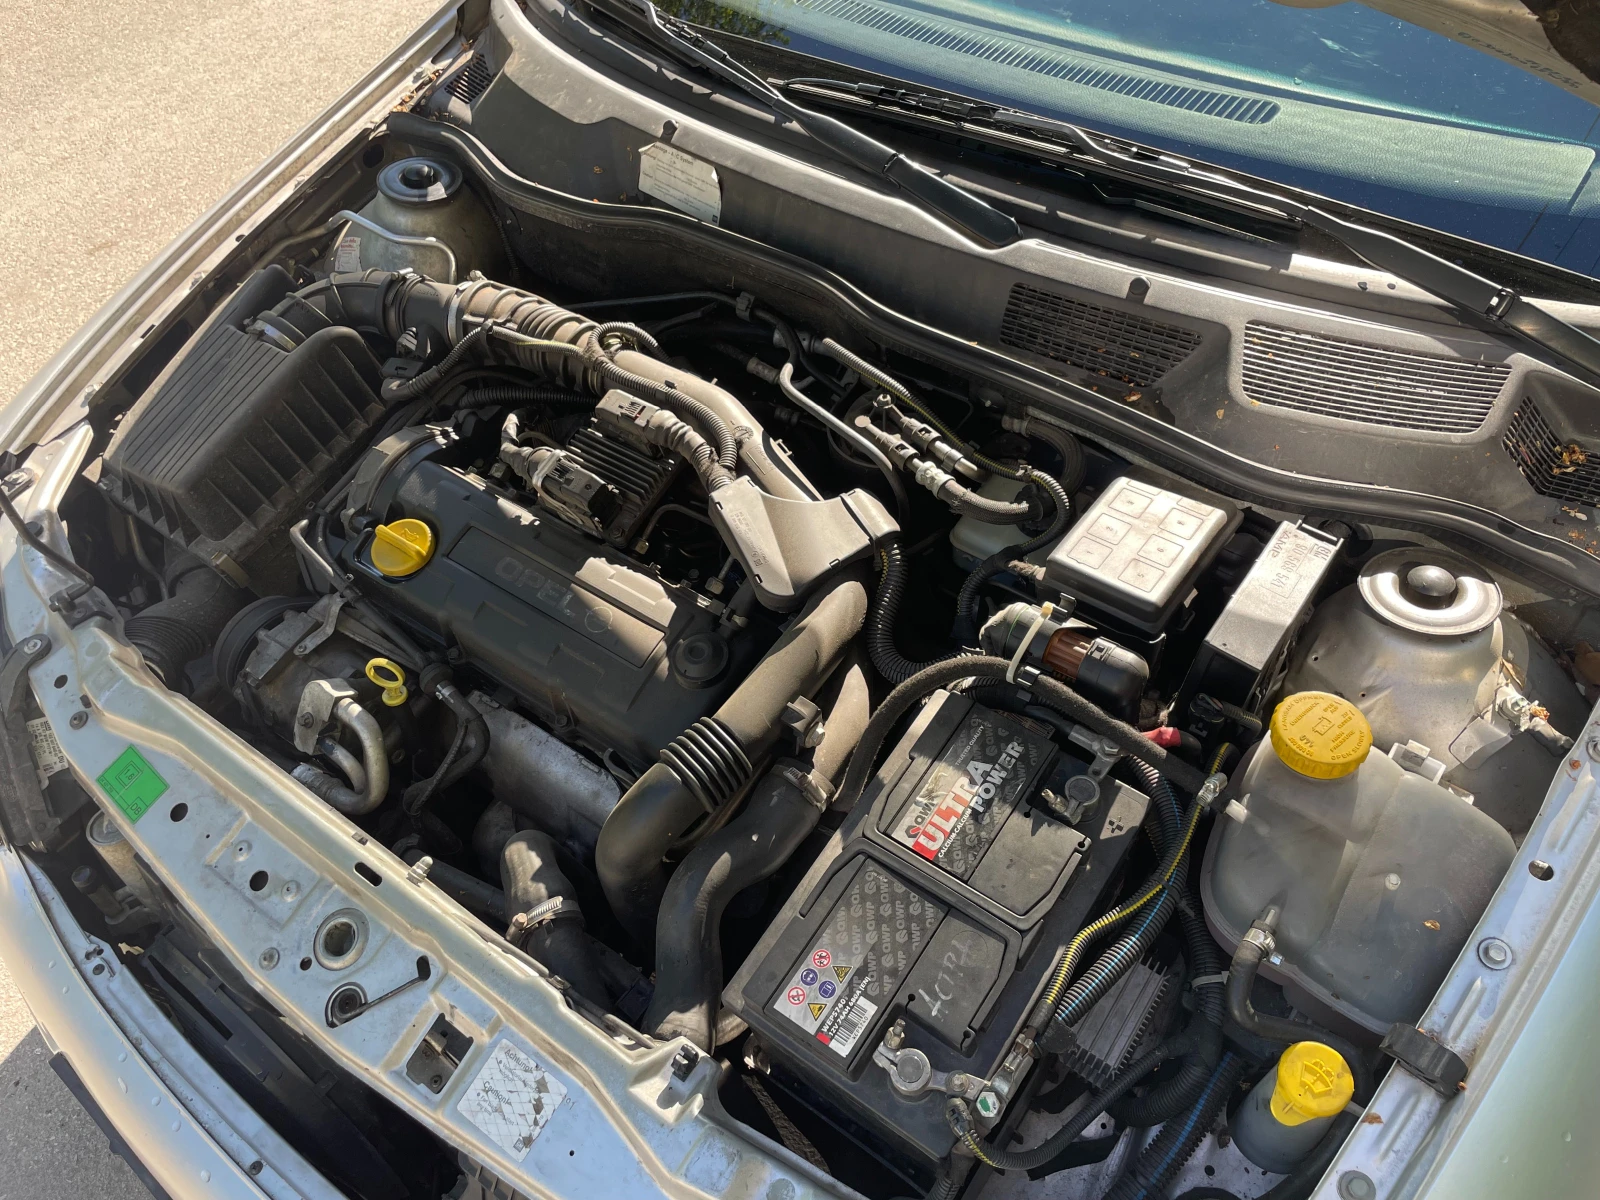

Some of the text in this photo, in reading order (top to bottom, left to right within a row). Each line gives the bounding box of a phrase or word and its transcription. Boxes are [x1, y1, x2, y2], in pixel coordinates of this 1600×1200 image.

[495, 556, 576, 617] OPEL
[955, 724, 985, 766] TRUSTED QUALITY
[972, 741, 1024, 813] POWER
[130, 803, 142, 815] DB
[918, 761, 994, 851] ULTRA
[938, 808, 972, 858] CALCIUM-CALCIUM
[828, 1022, 839, 1036] 12V
[836, 1005, 851, 1024] 74AH
[483, 1081, 510, 1104] Caution!
